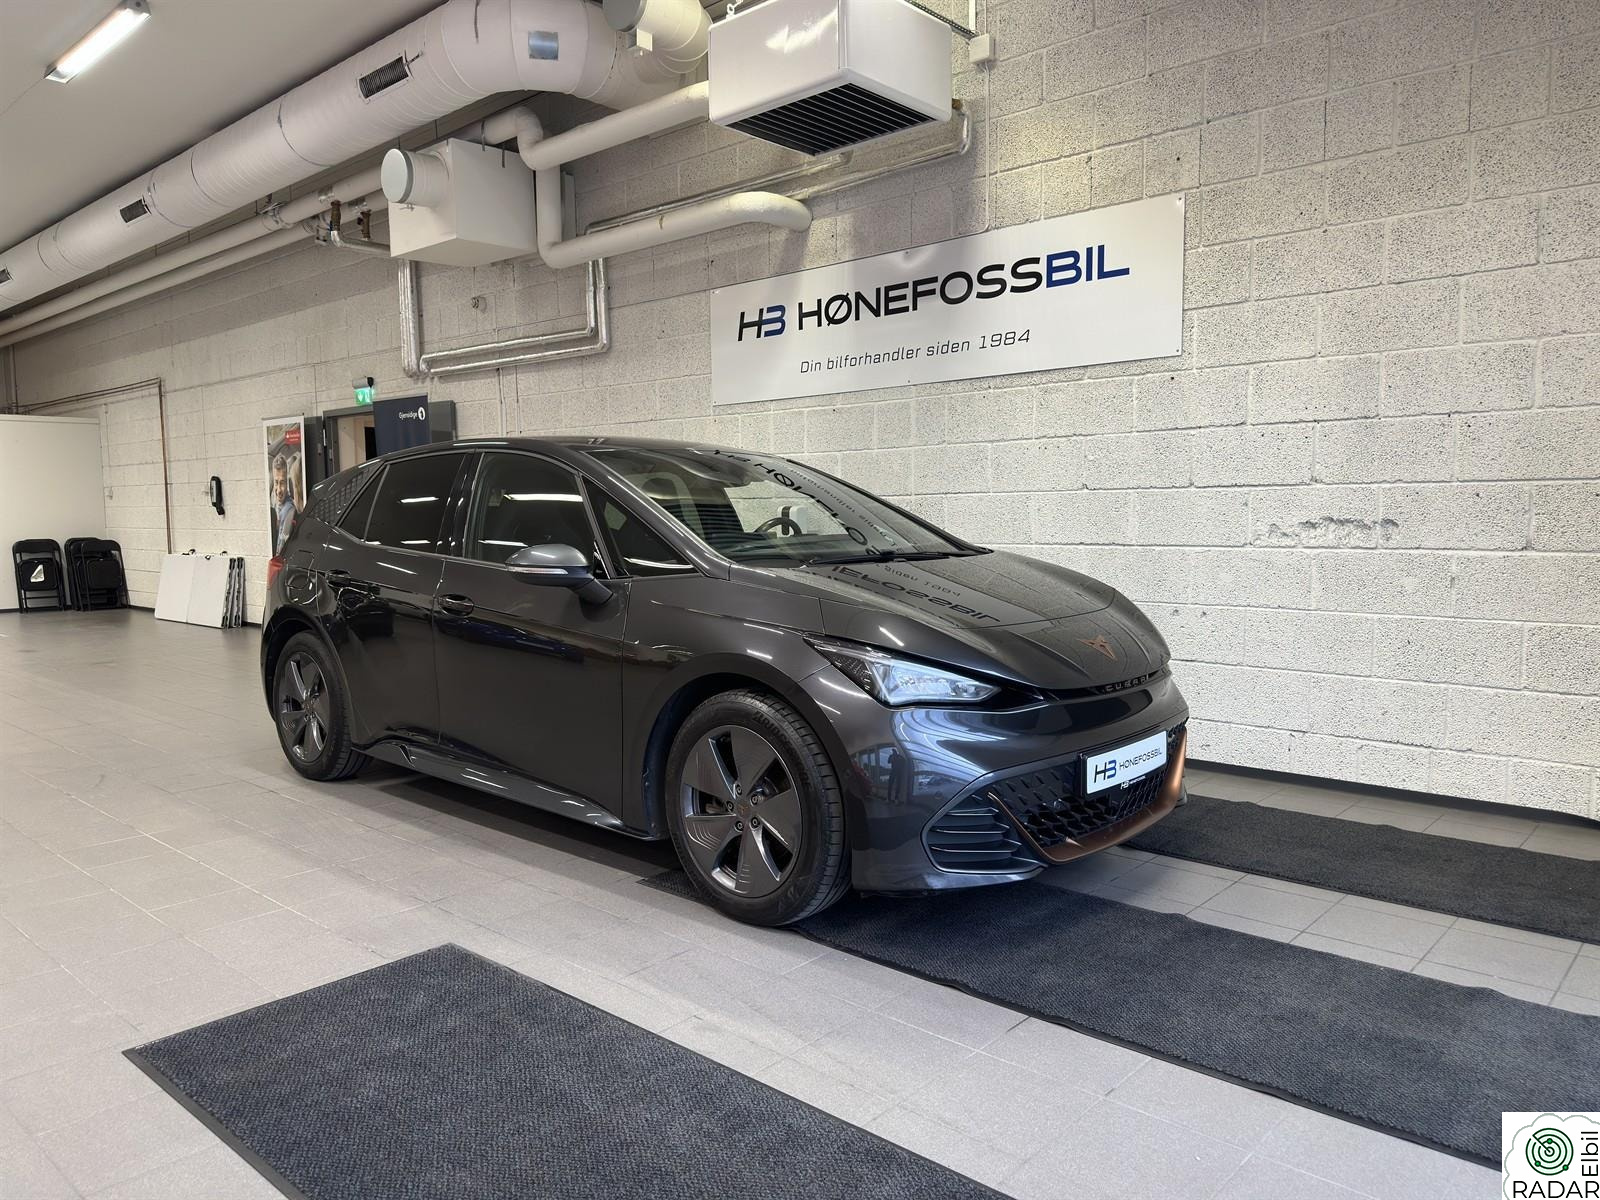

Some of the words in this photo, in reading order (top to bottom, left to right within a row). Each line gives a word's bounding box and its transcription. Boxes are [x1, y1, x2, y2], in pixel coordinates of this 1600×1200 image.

[737, 304, 786, 342] HB
[797, 244, 1130, 331] HØNEFOSSBIL
[800, 359, 822, 374] Din
[826, 346, 921, 370] bilforhandler
[926, 339, 970, 357] siden
[978, 329, 1031, 350] 1984
